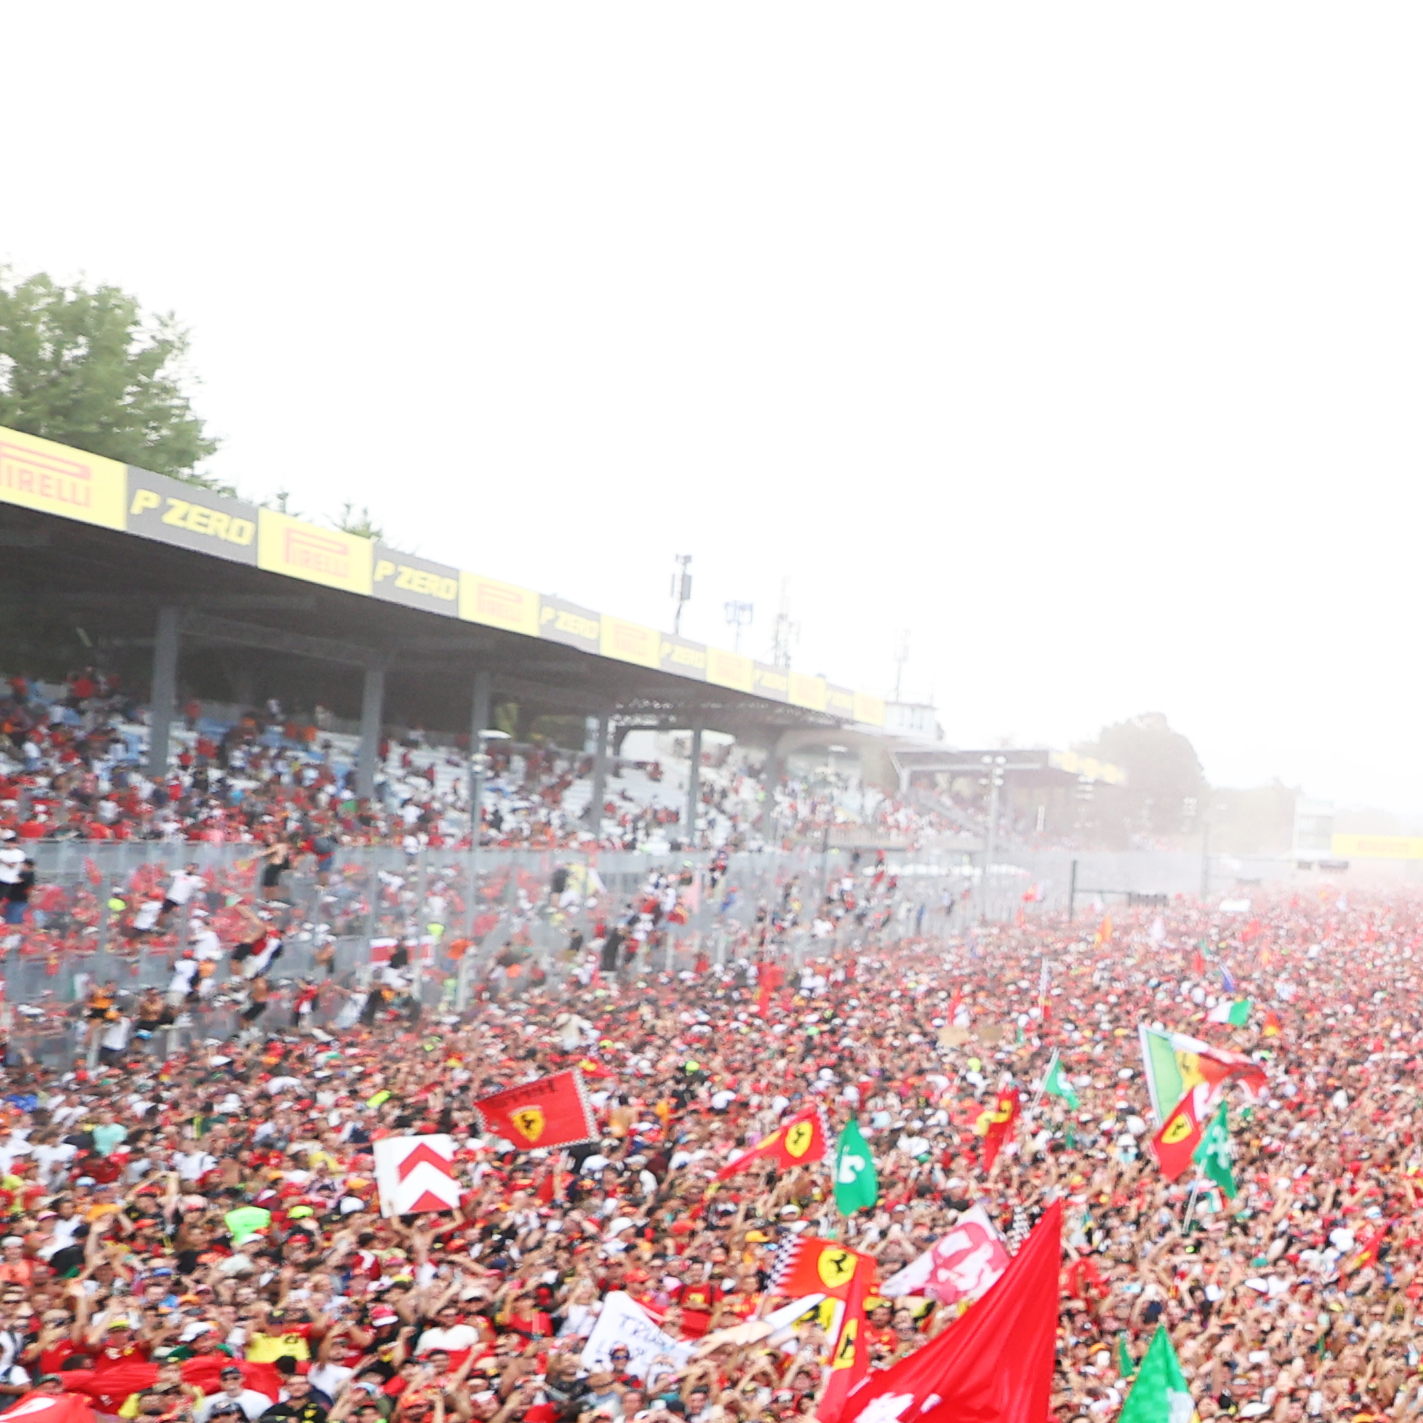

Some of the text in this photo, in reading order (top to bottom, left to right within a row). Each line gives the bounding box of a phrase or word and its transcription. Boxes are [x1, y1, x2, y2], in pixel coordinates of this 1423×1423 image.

[130, 489, 256, 546] P ZERO
[374, 560, 459, 601] P ZERO
